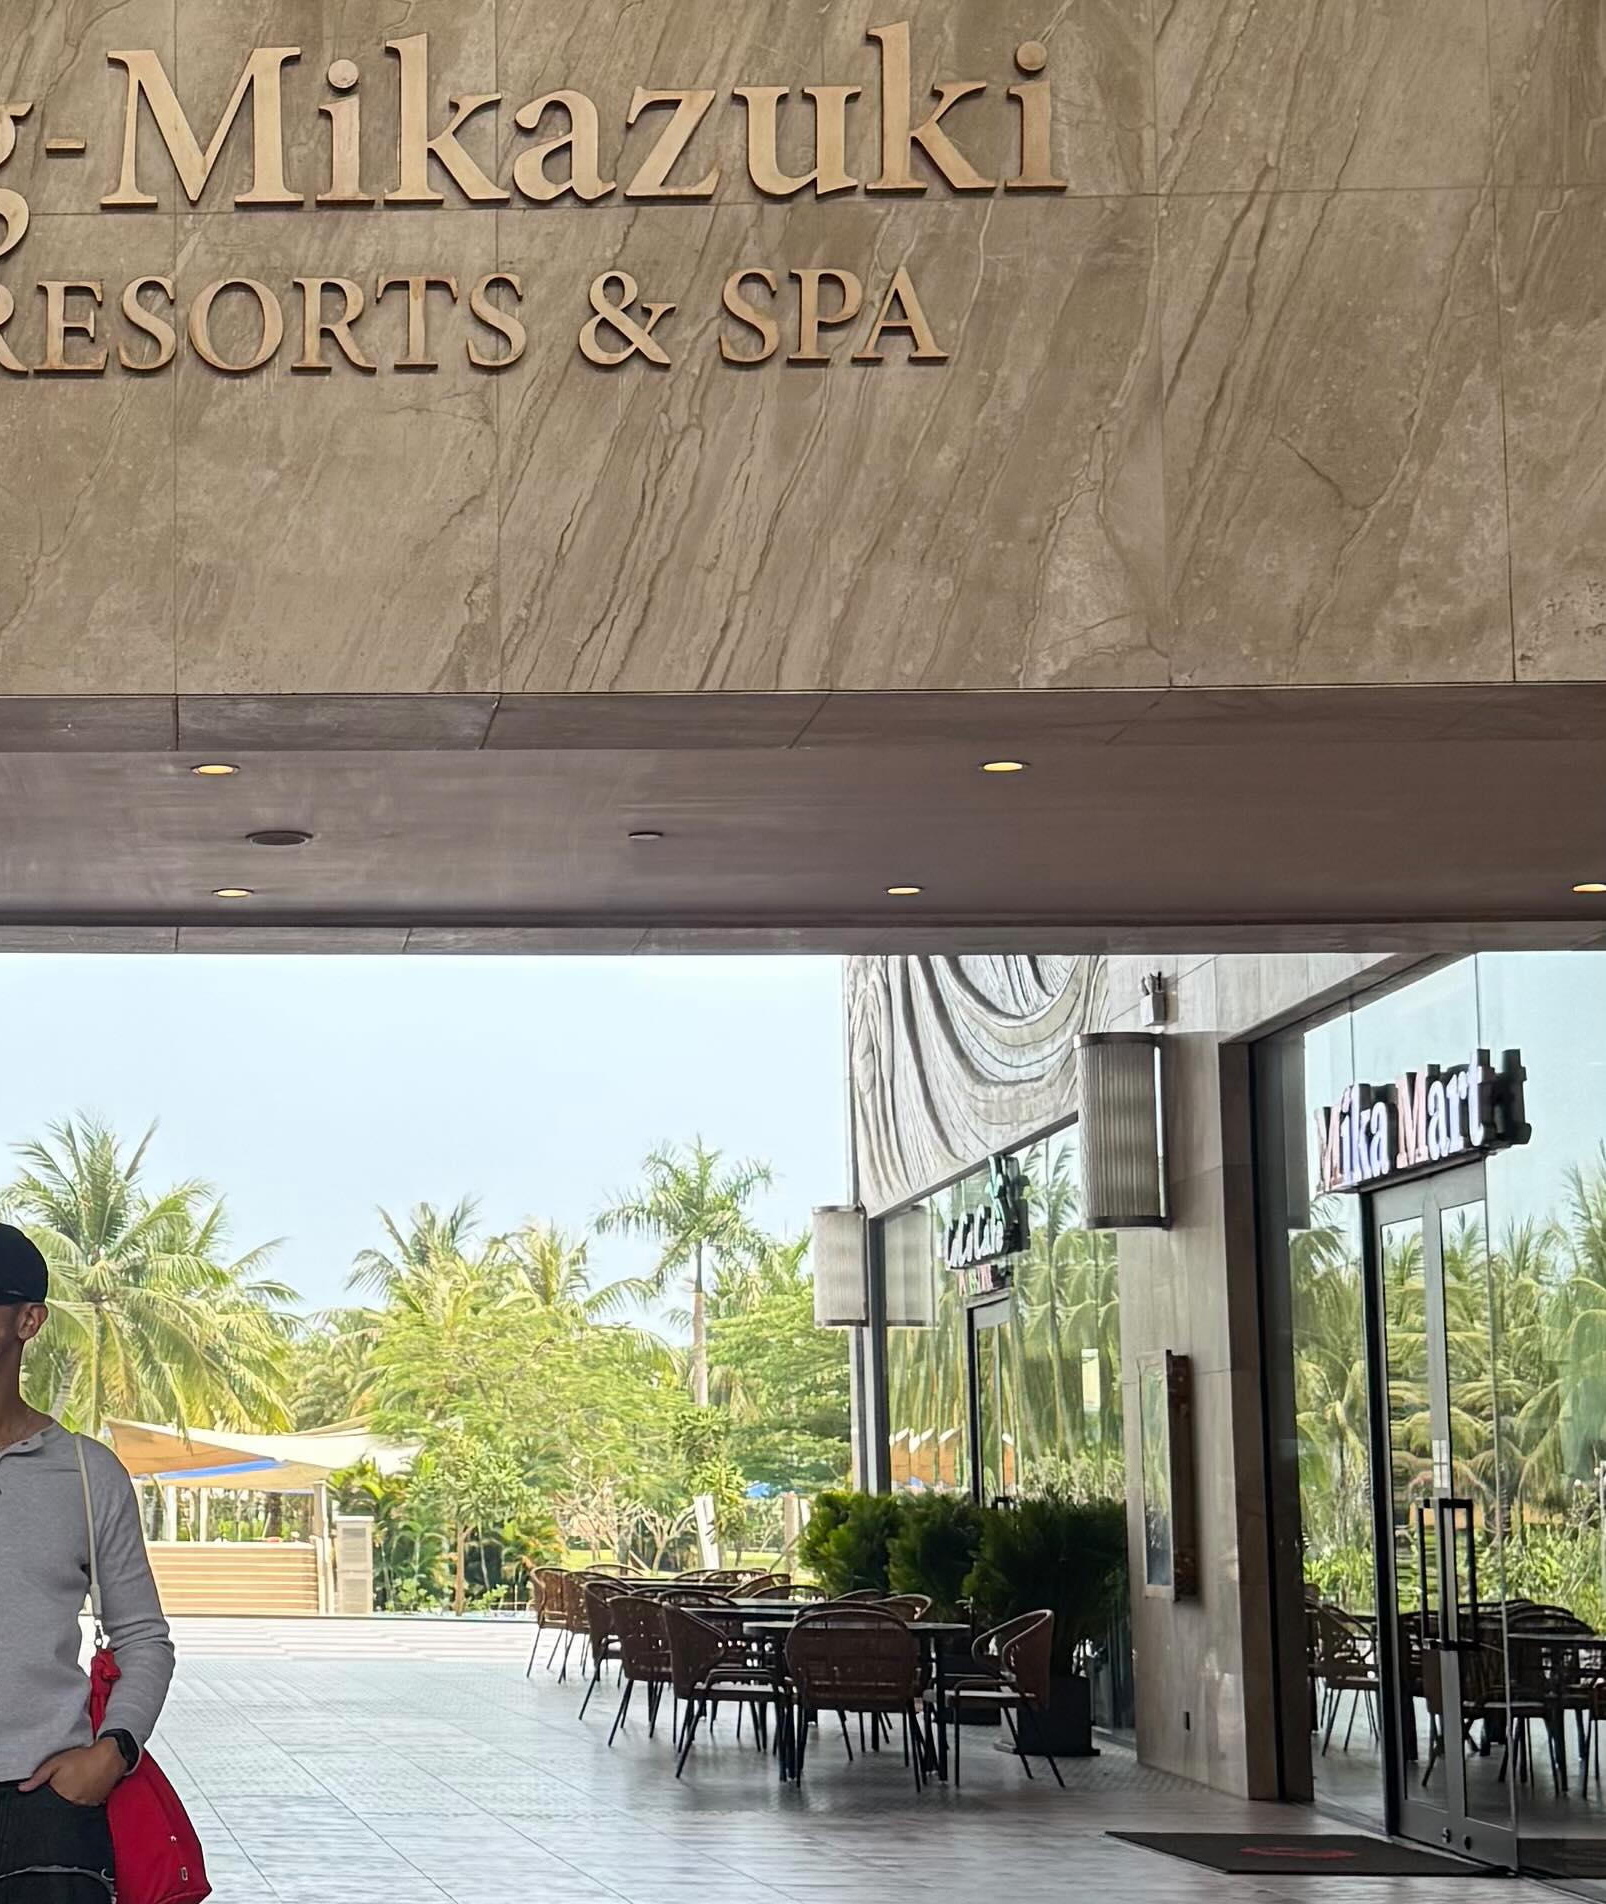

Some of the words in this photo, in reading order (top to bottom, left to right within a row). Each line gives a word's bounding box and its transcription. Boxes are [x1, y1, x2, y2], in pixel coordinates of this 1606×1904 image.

[578, 270, 678, 367] &
[719, 264, 949, 364] SPA
[1315, 1083, 1390, 1192] Mika
[1396, 1051, 1484, 1169] Mart
